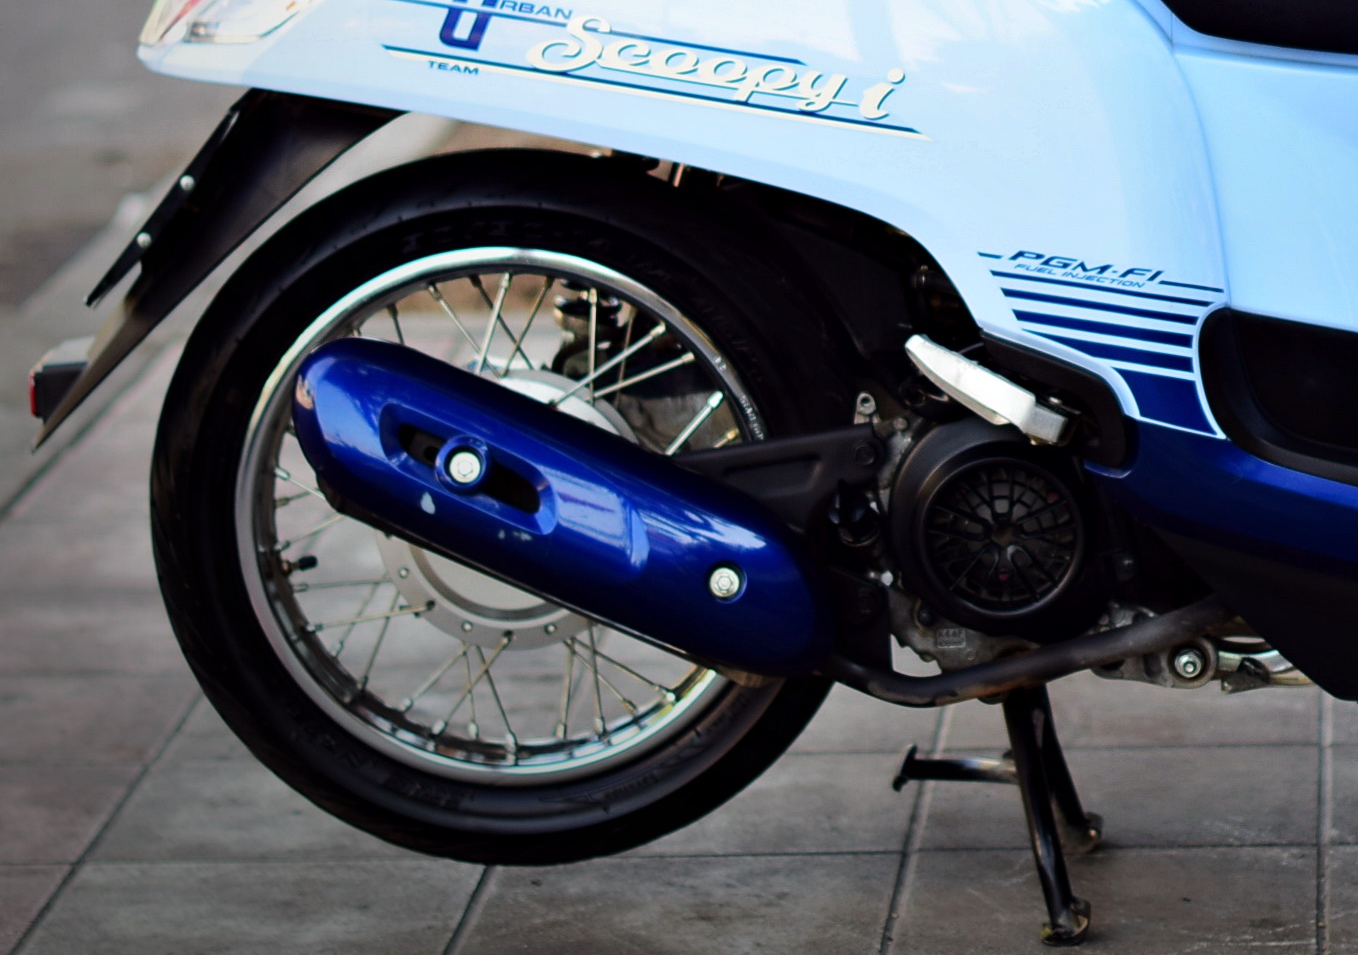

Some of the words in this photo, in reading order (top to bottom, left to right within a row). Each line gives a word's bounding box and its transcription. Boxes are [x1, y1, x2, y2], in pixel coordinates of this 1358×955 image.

[428, 60, 479, 75] TEAM
[526, 14, 858, 112] Scoopy
[1014, 263, 1056, 276] FUEL
[1062, 270, 1145, 289] INJECTION
